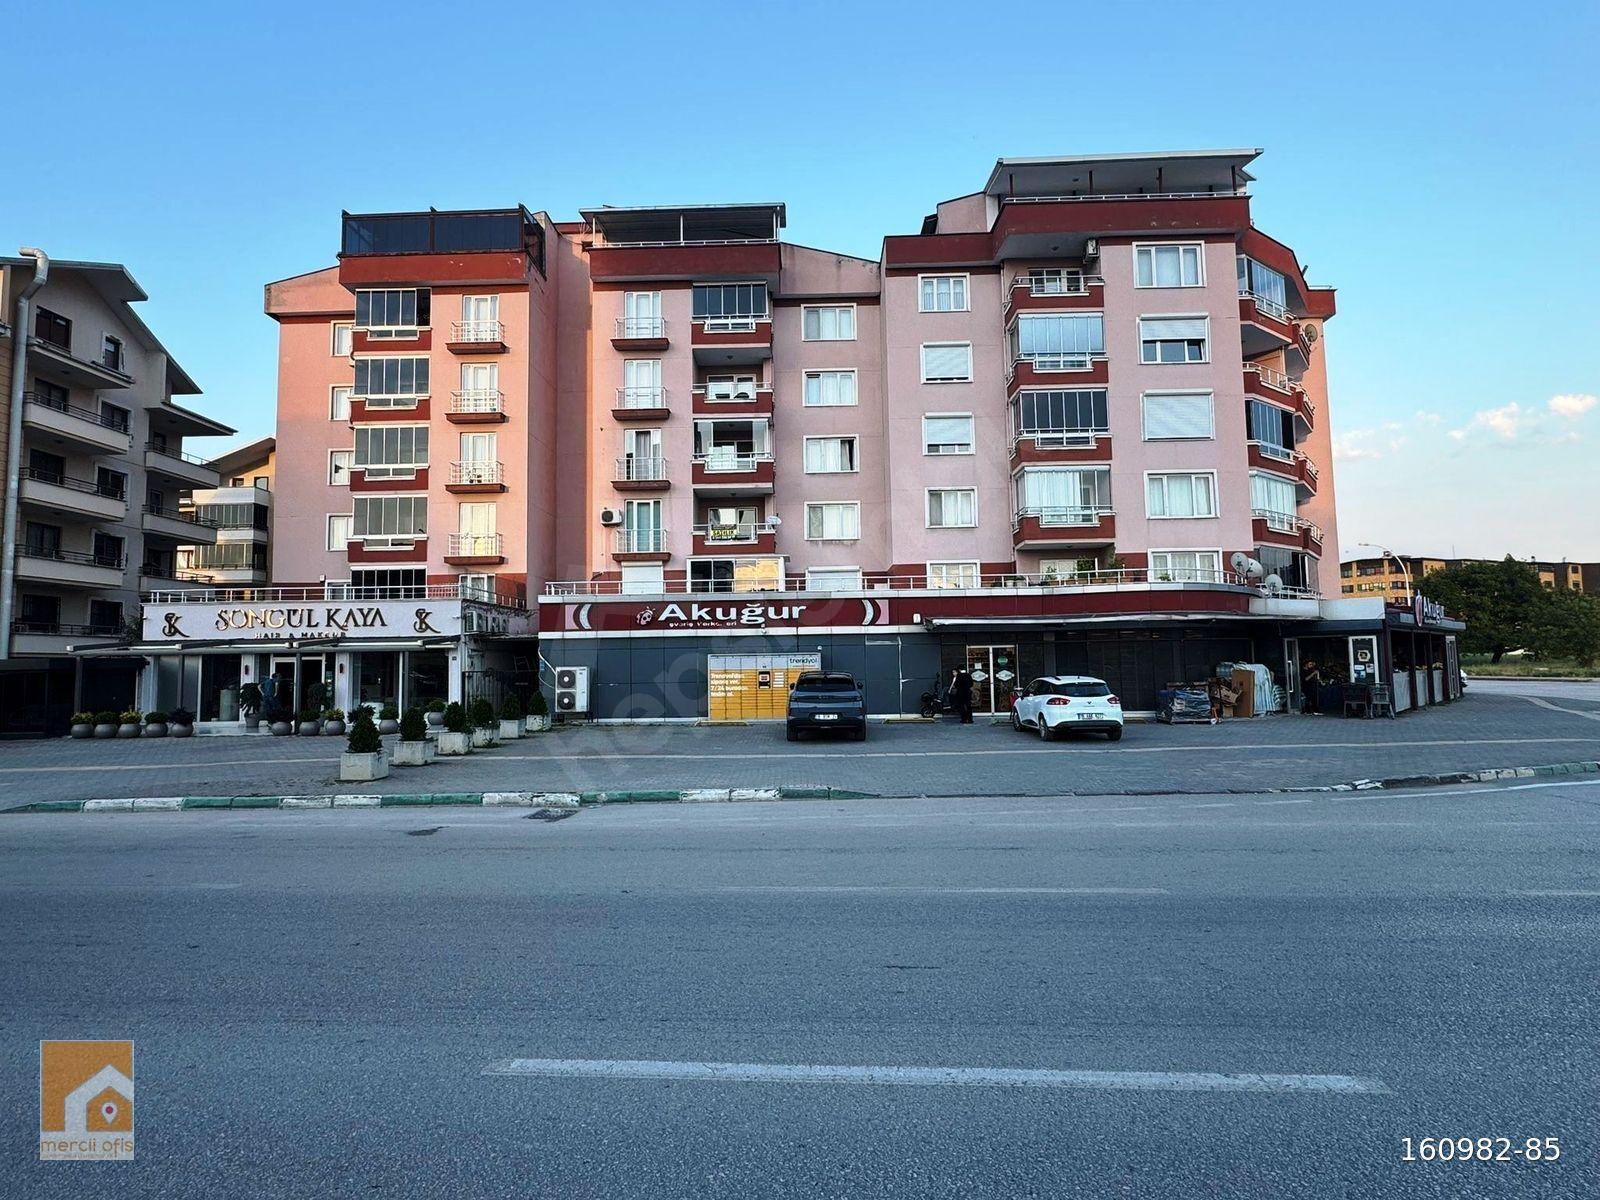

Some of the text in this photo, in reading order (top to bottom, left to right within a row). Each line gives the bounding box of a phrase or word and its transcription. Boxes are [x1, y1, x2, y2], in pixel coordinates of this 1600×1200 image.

[216, 607, 388, 631] SONGÜL KAYA
[658, 603, 807, 625] Akuğur
[789, 657, 818, 665] trendyol
